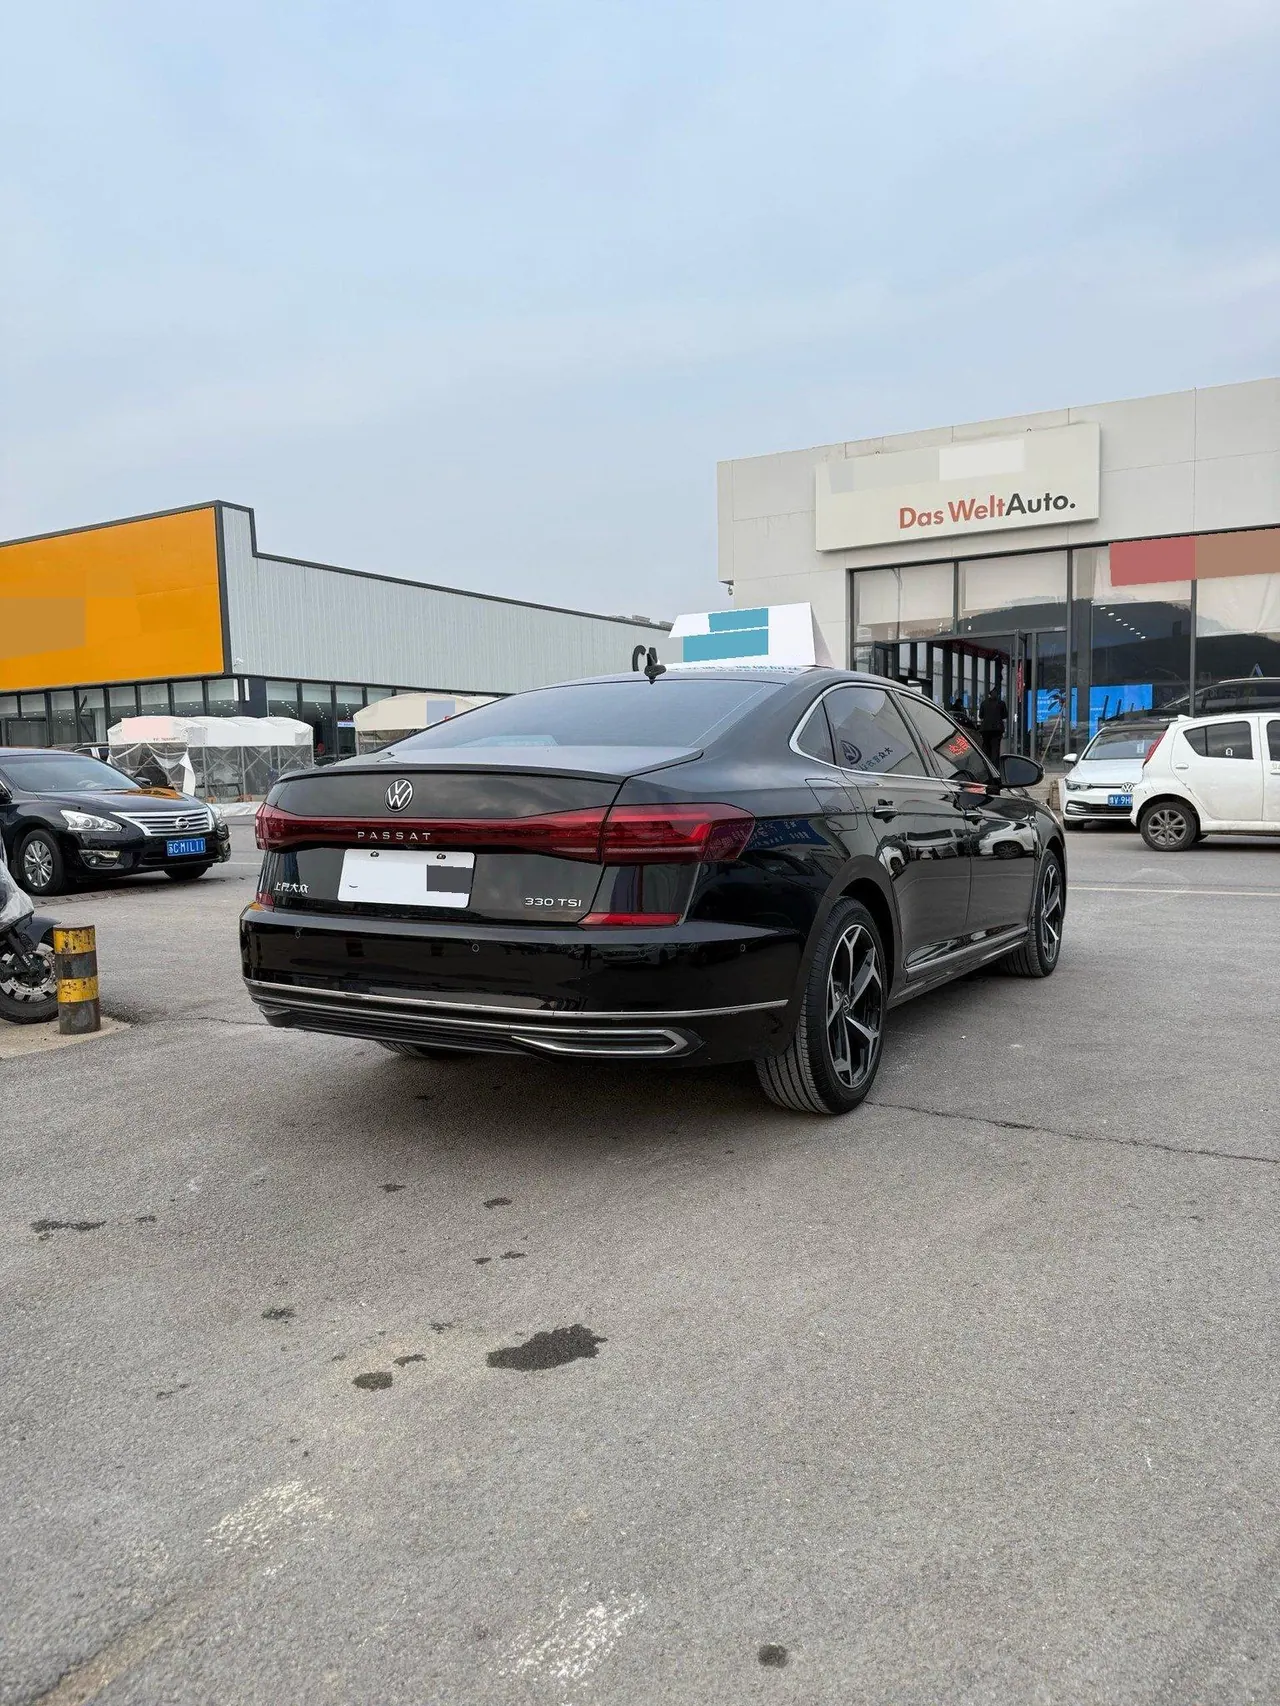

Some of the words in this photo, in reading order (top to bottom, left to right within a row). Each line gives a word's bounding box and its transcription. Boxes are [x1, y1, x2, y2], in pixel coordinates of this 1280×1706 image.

[899, 507, 944, 529] Das
[357, 831, 431, 841] PASSAT
[524, 897, 554, 906] 330
[557, 898, 582, 907] TSI
